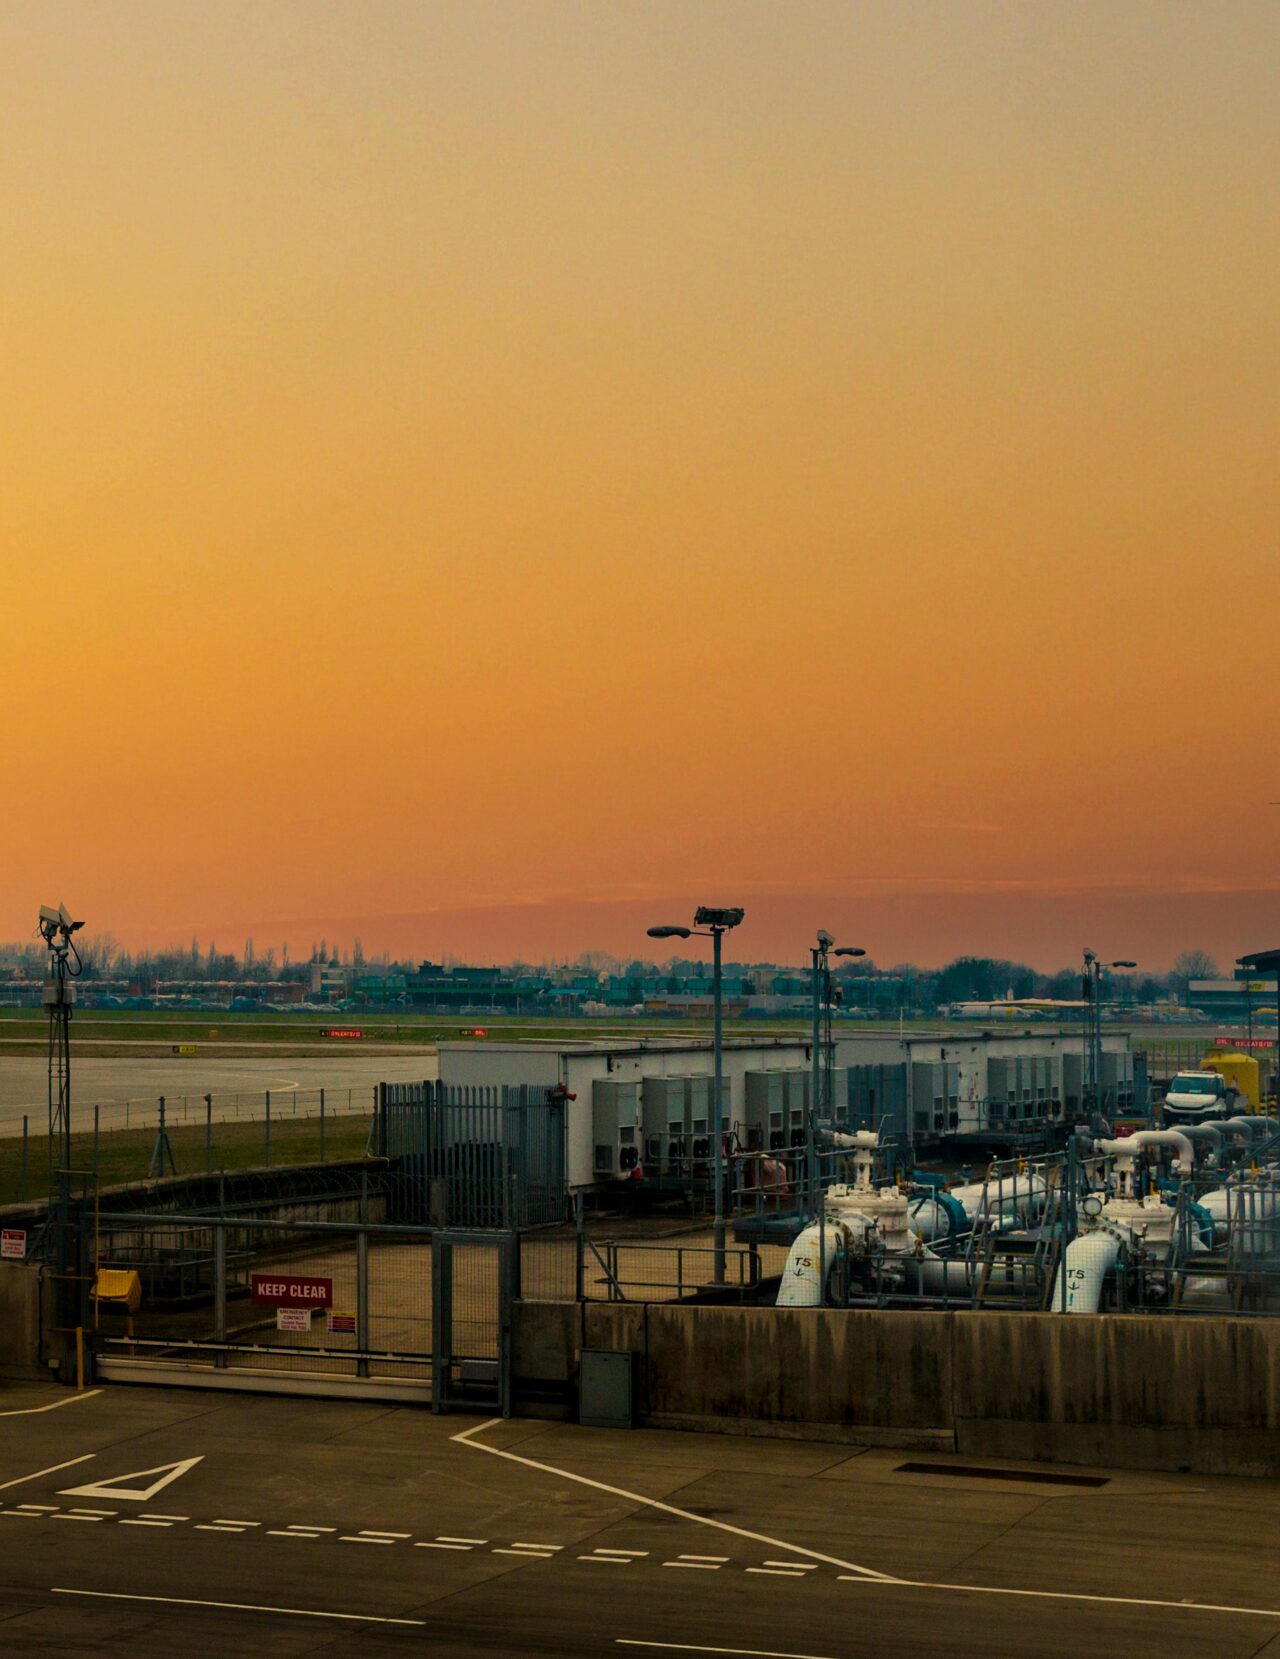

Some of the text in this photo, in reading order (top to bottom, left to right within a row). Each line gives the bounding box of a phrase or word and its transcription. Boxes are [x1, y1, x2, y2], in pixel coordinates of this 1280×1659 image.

[795, 1257, 812, 1267] T5
[1067, 1269, 1085, 1279] T5
[258, 1283, 326, 1299] KEEP CLEAR
